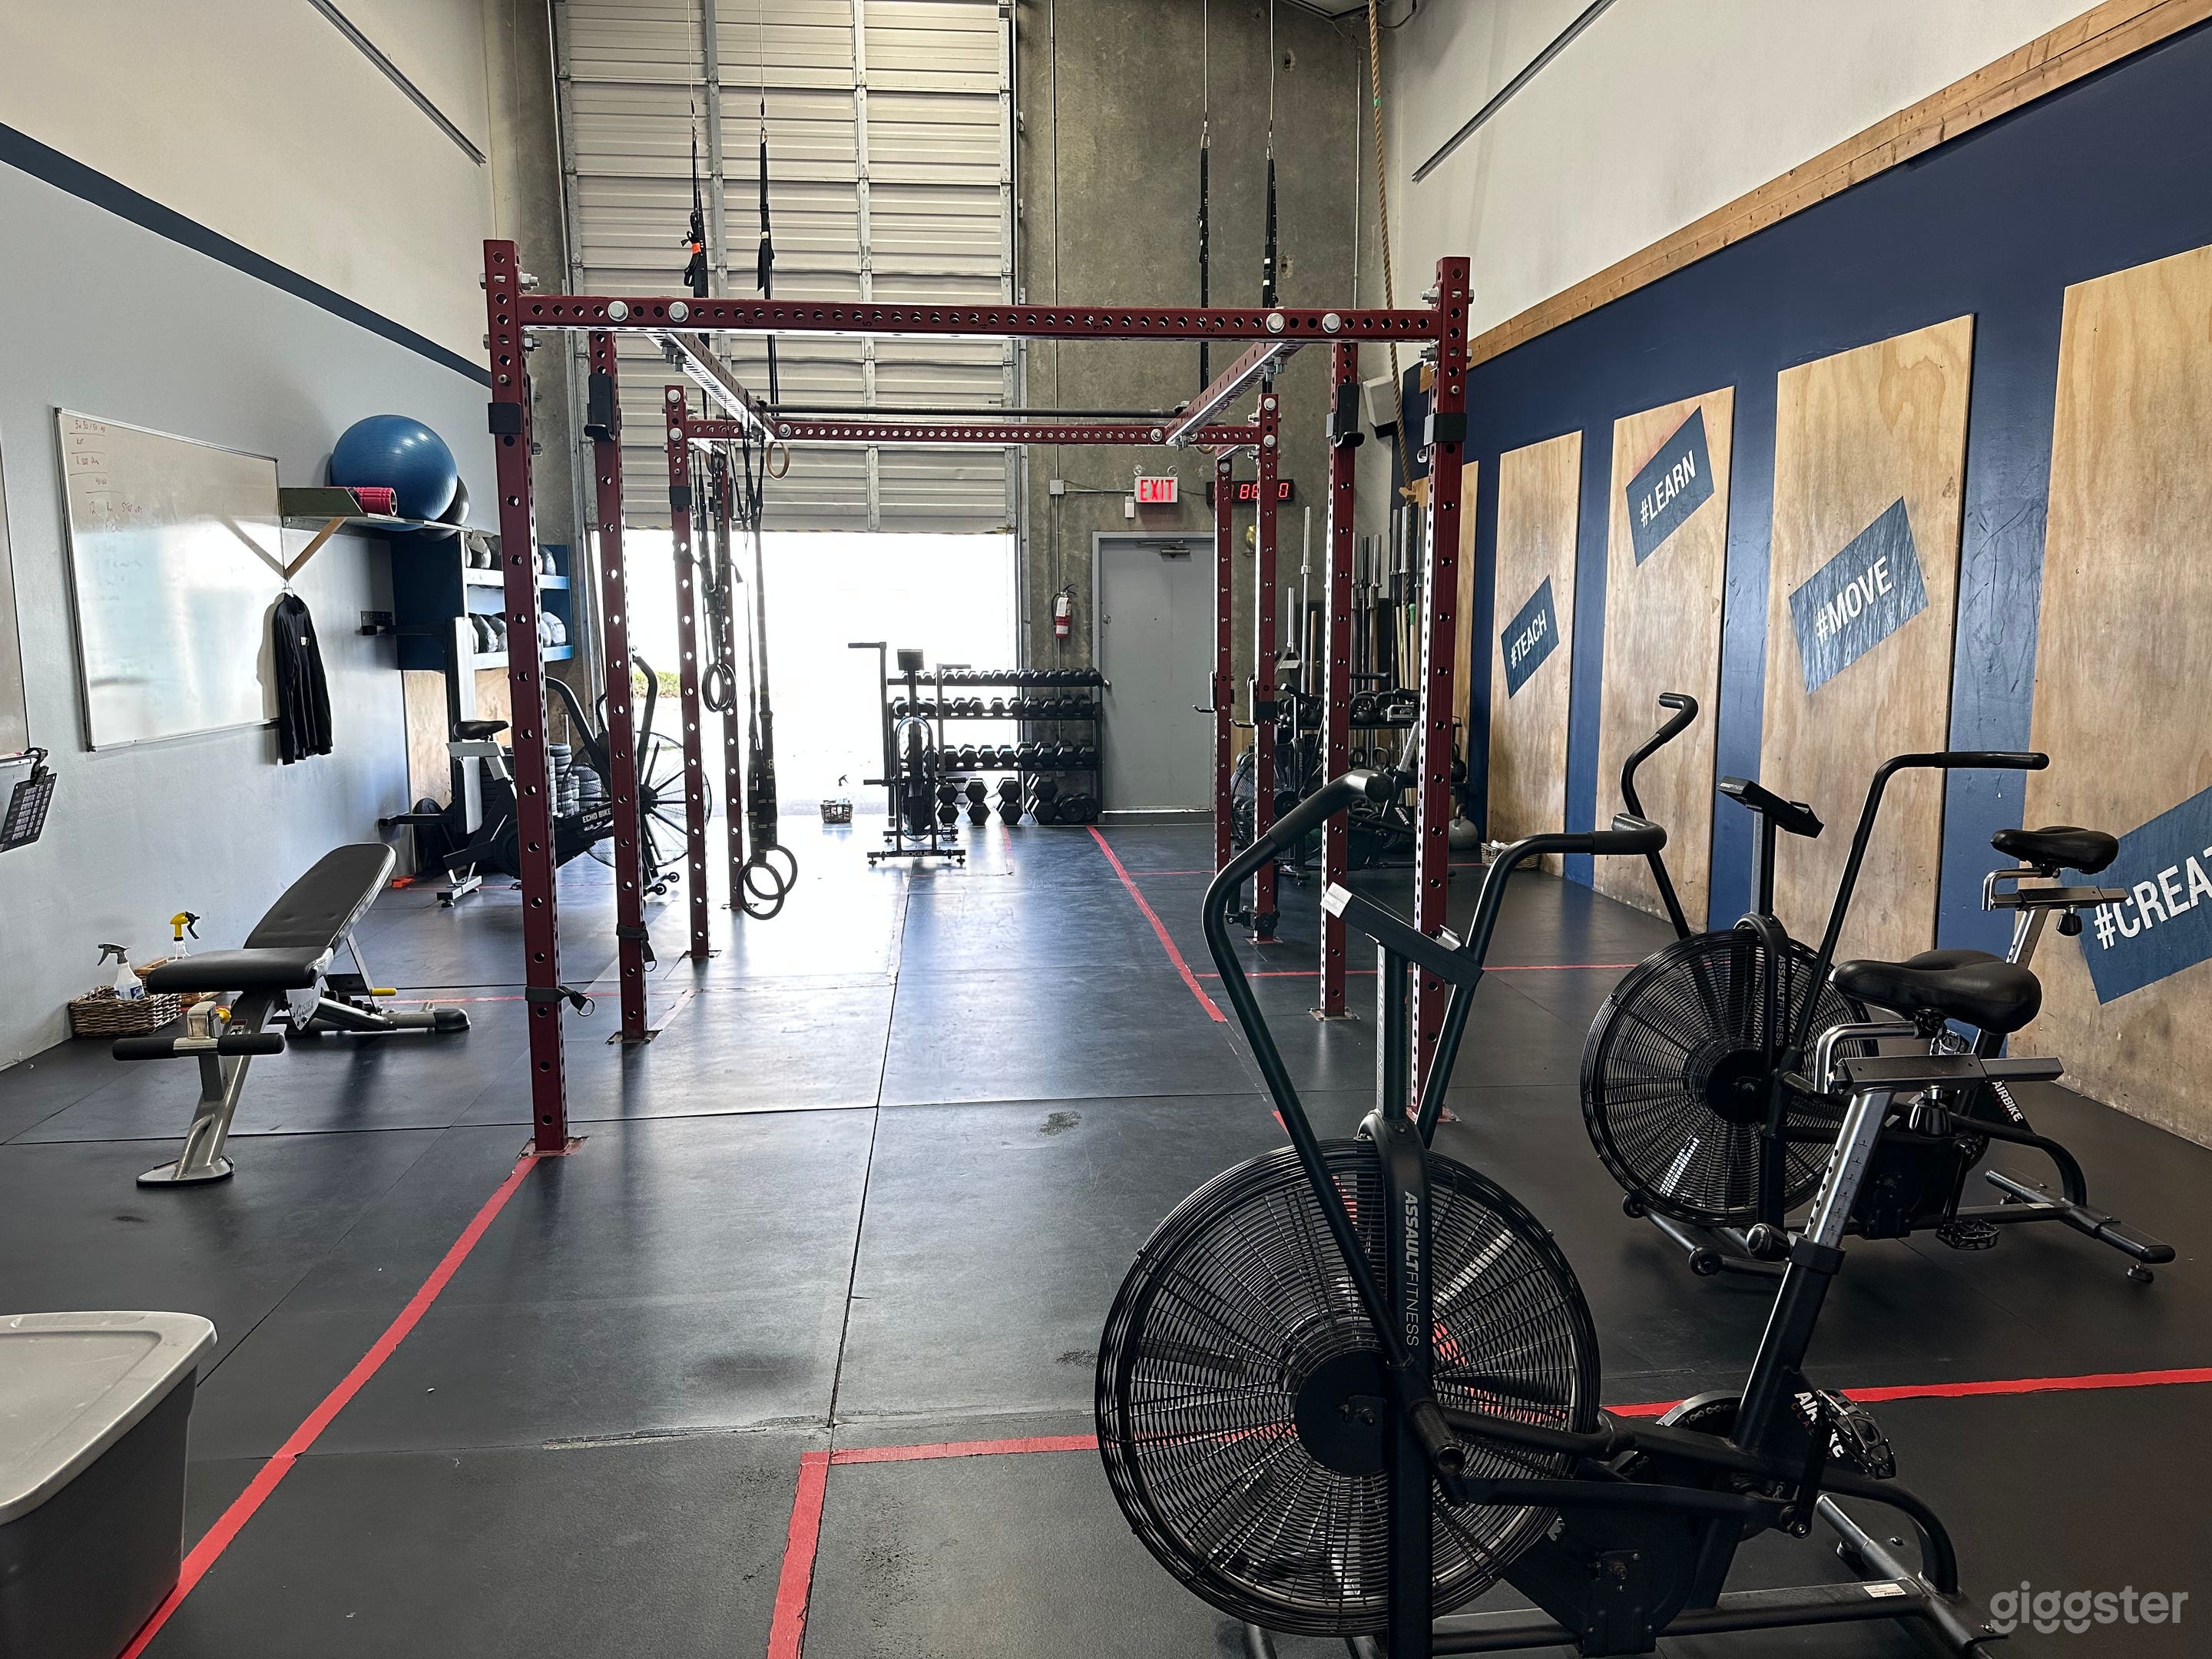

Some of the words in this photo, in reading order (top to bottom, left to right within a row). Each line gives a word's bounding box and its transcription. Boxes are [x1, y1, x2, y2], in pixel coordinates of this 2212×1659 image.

[1140, 479, 1174, 502] EXIT
[1640, 449, 1697, 528] #LEARN
[1510, 608, 1548, 670] #TEACH
[1816, 555, 1893, 647] #MOVE
[582, 812, 598, 823] ECHO
[598, 808, 611, 818] BIKE
[2094, 846, 2212, 950] #CREA
[1776, 954, 1786, 1046] ASSAULTFITNESS
[1992, 1081, 2024, 1121] AIRBIKE
[1405, 1190, 1419, 1346] ASSAULTFITNESS
